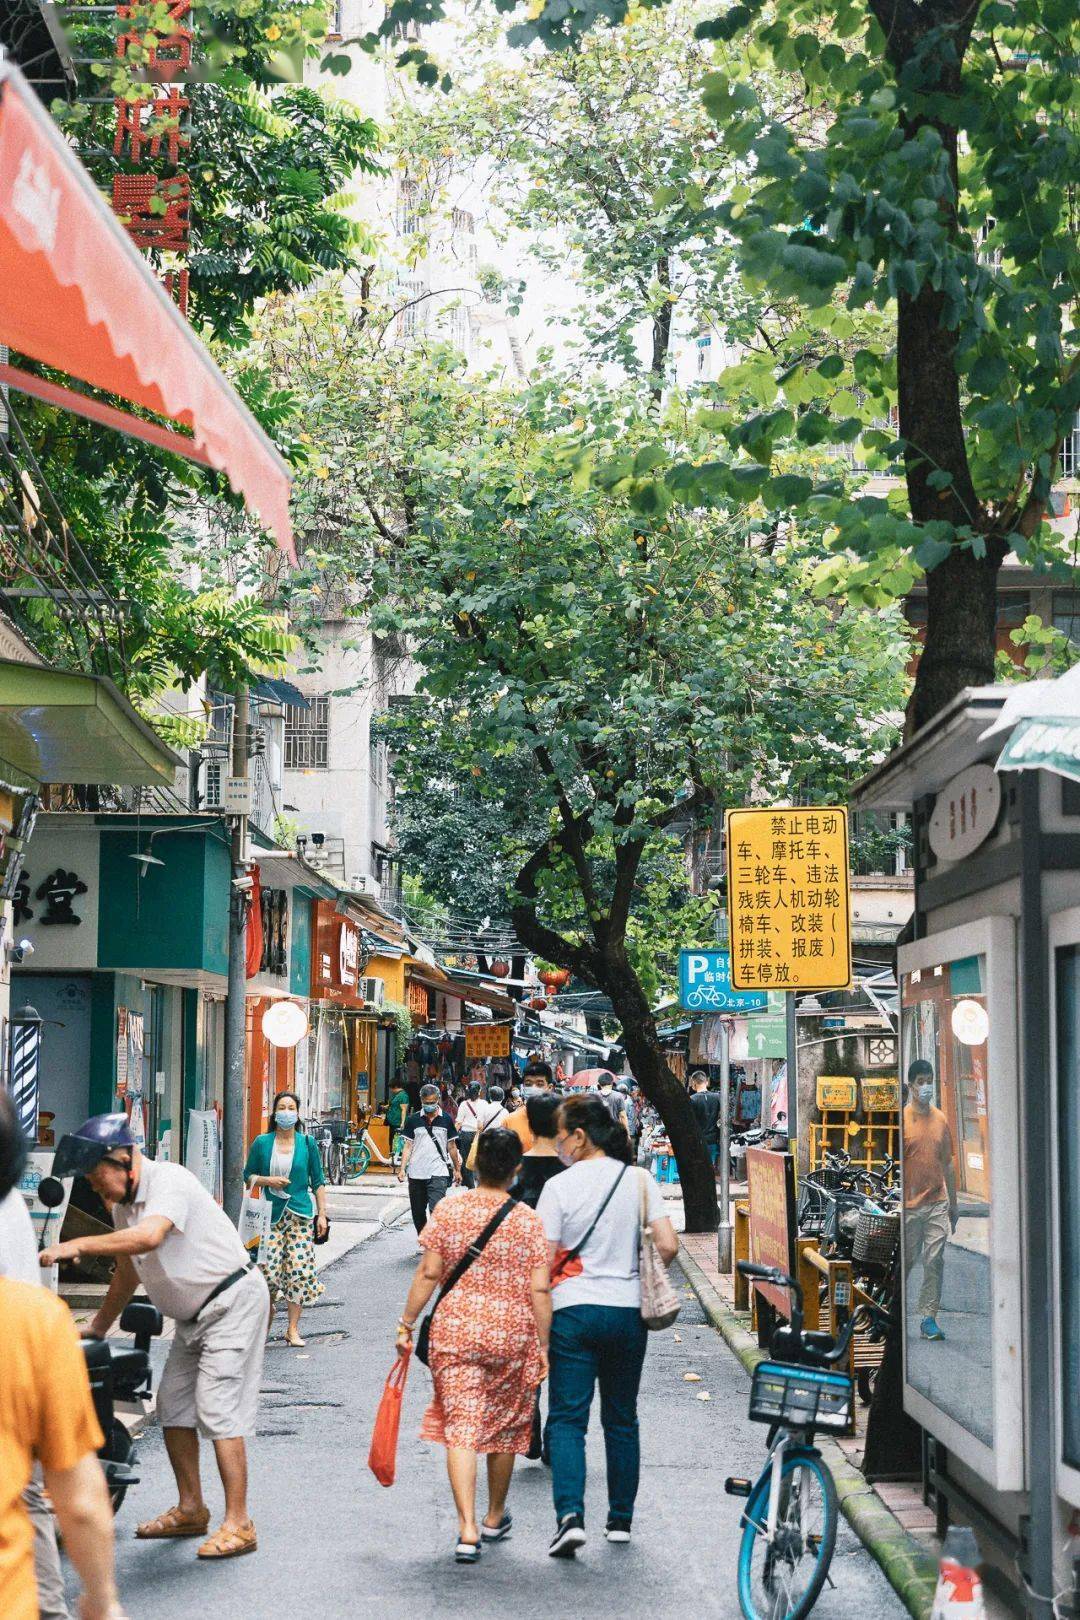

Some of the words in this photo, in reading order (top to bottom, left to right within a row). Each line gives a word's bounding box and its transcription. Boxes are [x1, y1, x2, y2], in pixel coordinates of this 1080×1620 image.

[771, 815, 837, 835] 禁止电动
[737, 840, 830, 861] 车、摩托车、
[738, 864, 839, 885] 三轮车、违法
[738, 888, 840, 909] 残疾人机动轮
[688, 955, 709, 984] P
[716, 956, 730, 969] 自
[704, 971, 730, 983] 临时
[740, 963, 799, 983] 车停放。
[727, 998, 761, 1008] 北京-10
